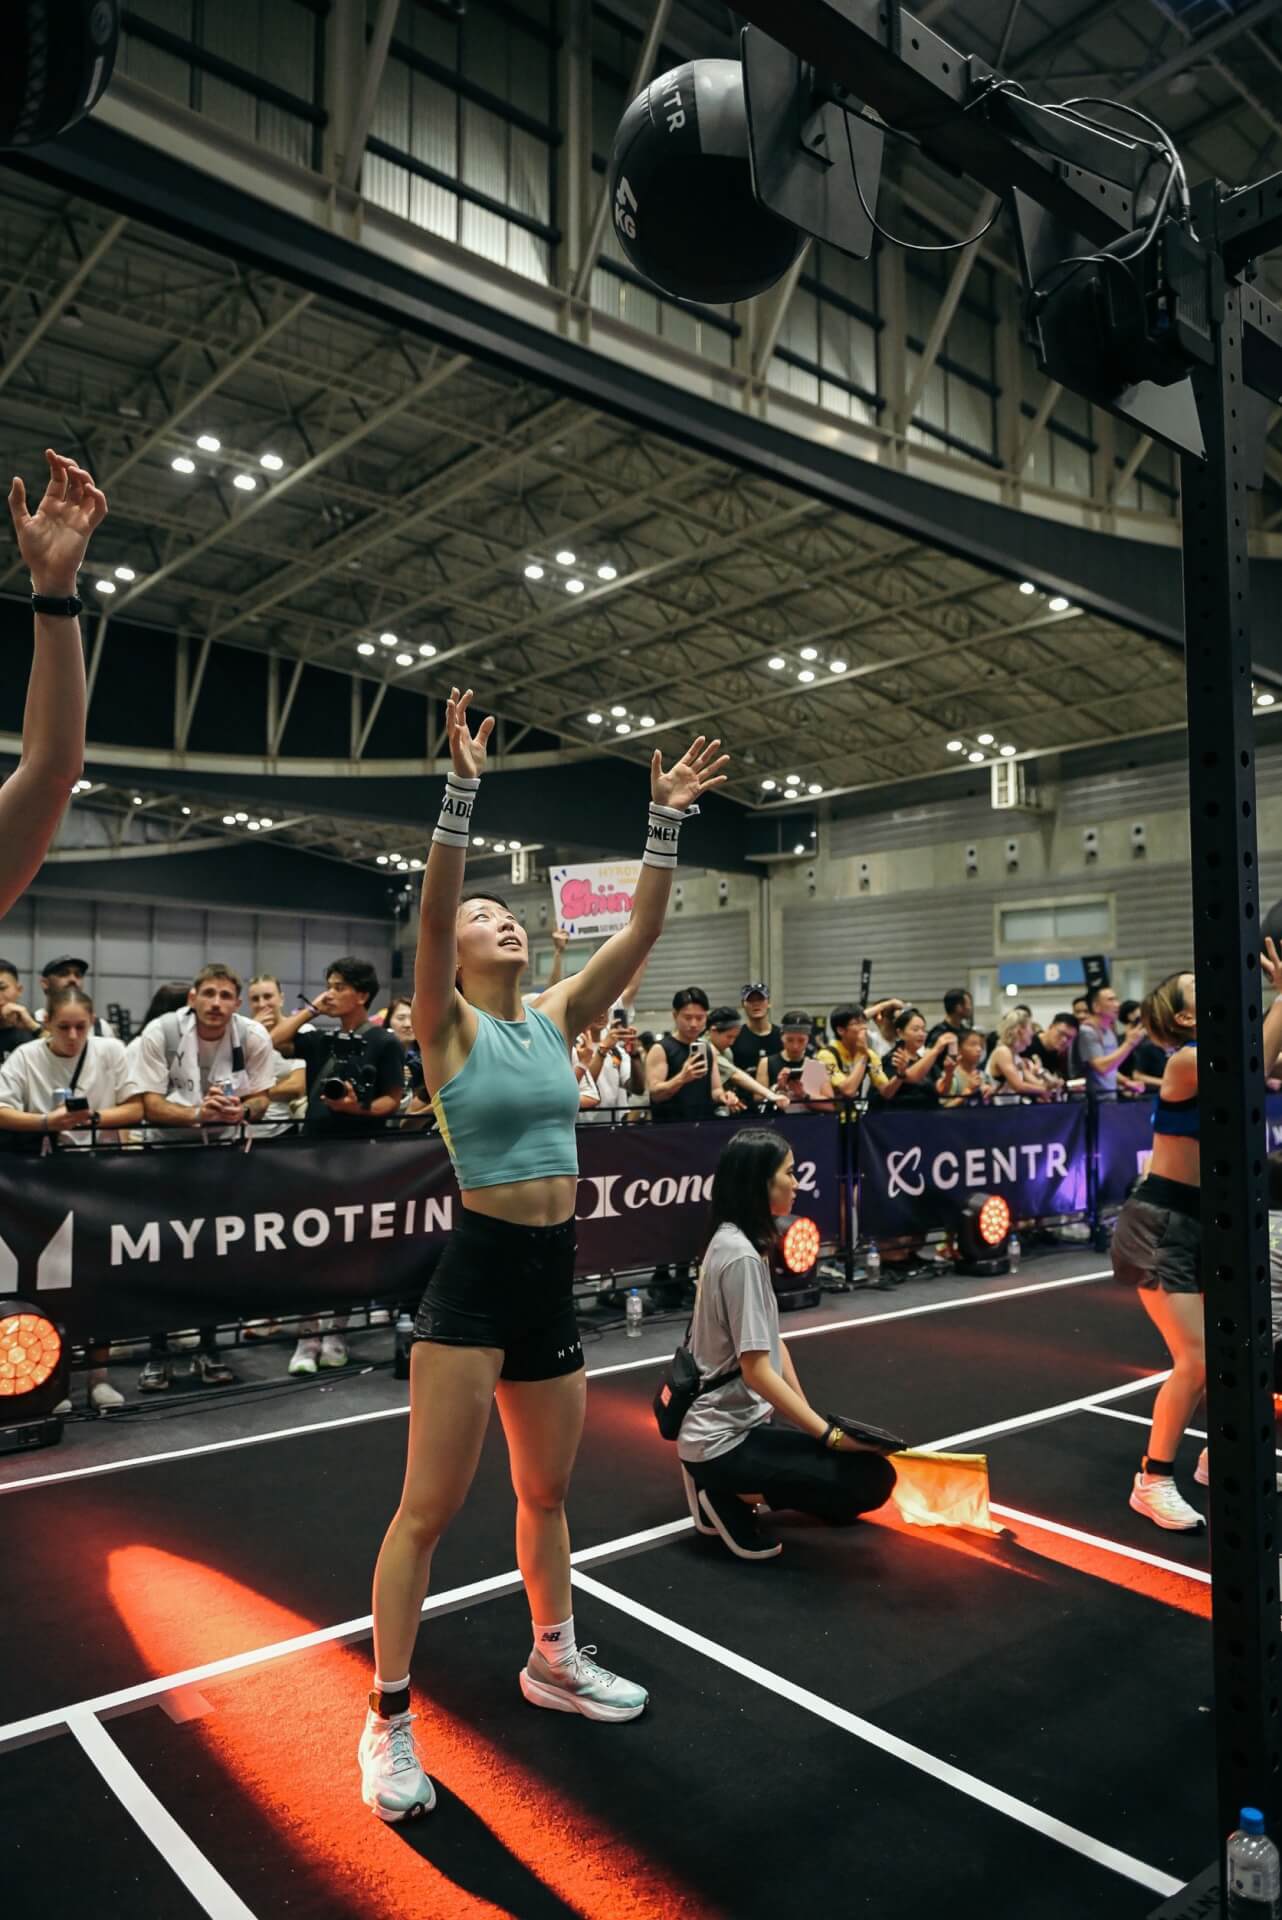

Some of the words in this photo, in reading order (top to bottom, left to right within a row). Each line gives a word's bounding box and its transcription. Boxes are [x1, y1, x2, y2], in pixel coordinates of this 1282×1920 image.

[660, 72, 686, 133] NTR
[615, 202, 636, 240] KG
[560, 878, 635, 920] Shiin
[932, 1142, 1069, 1191] CENTR
[110, 1195, 453, 1266] MYPROTEIN
